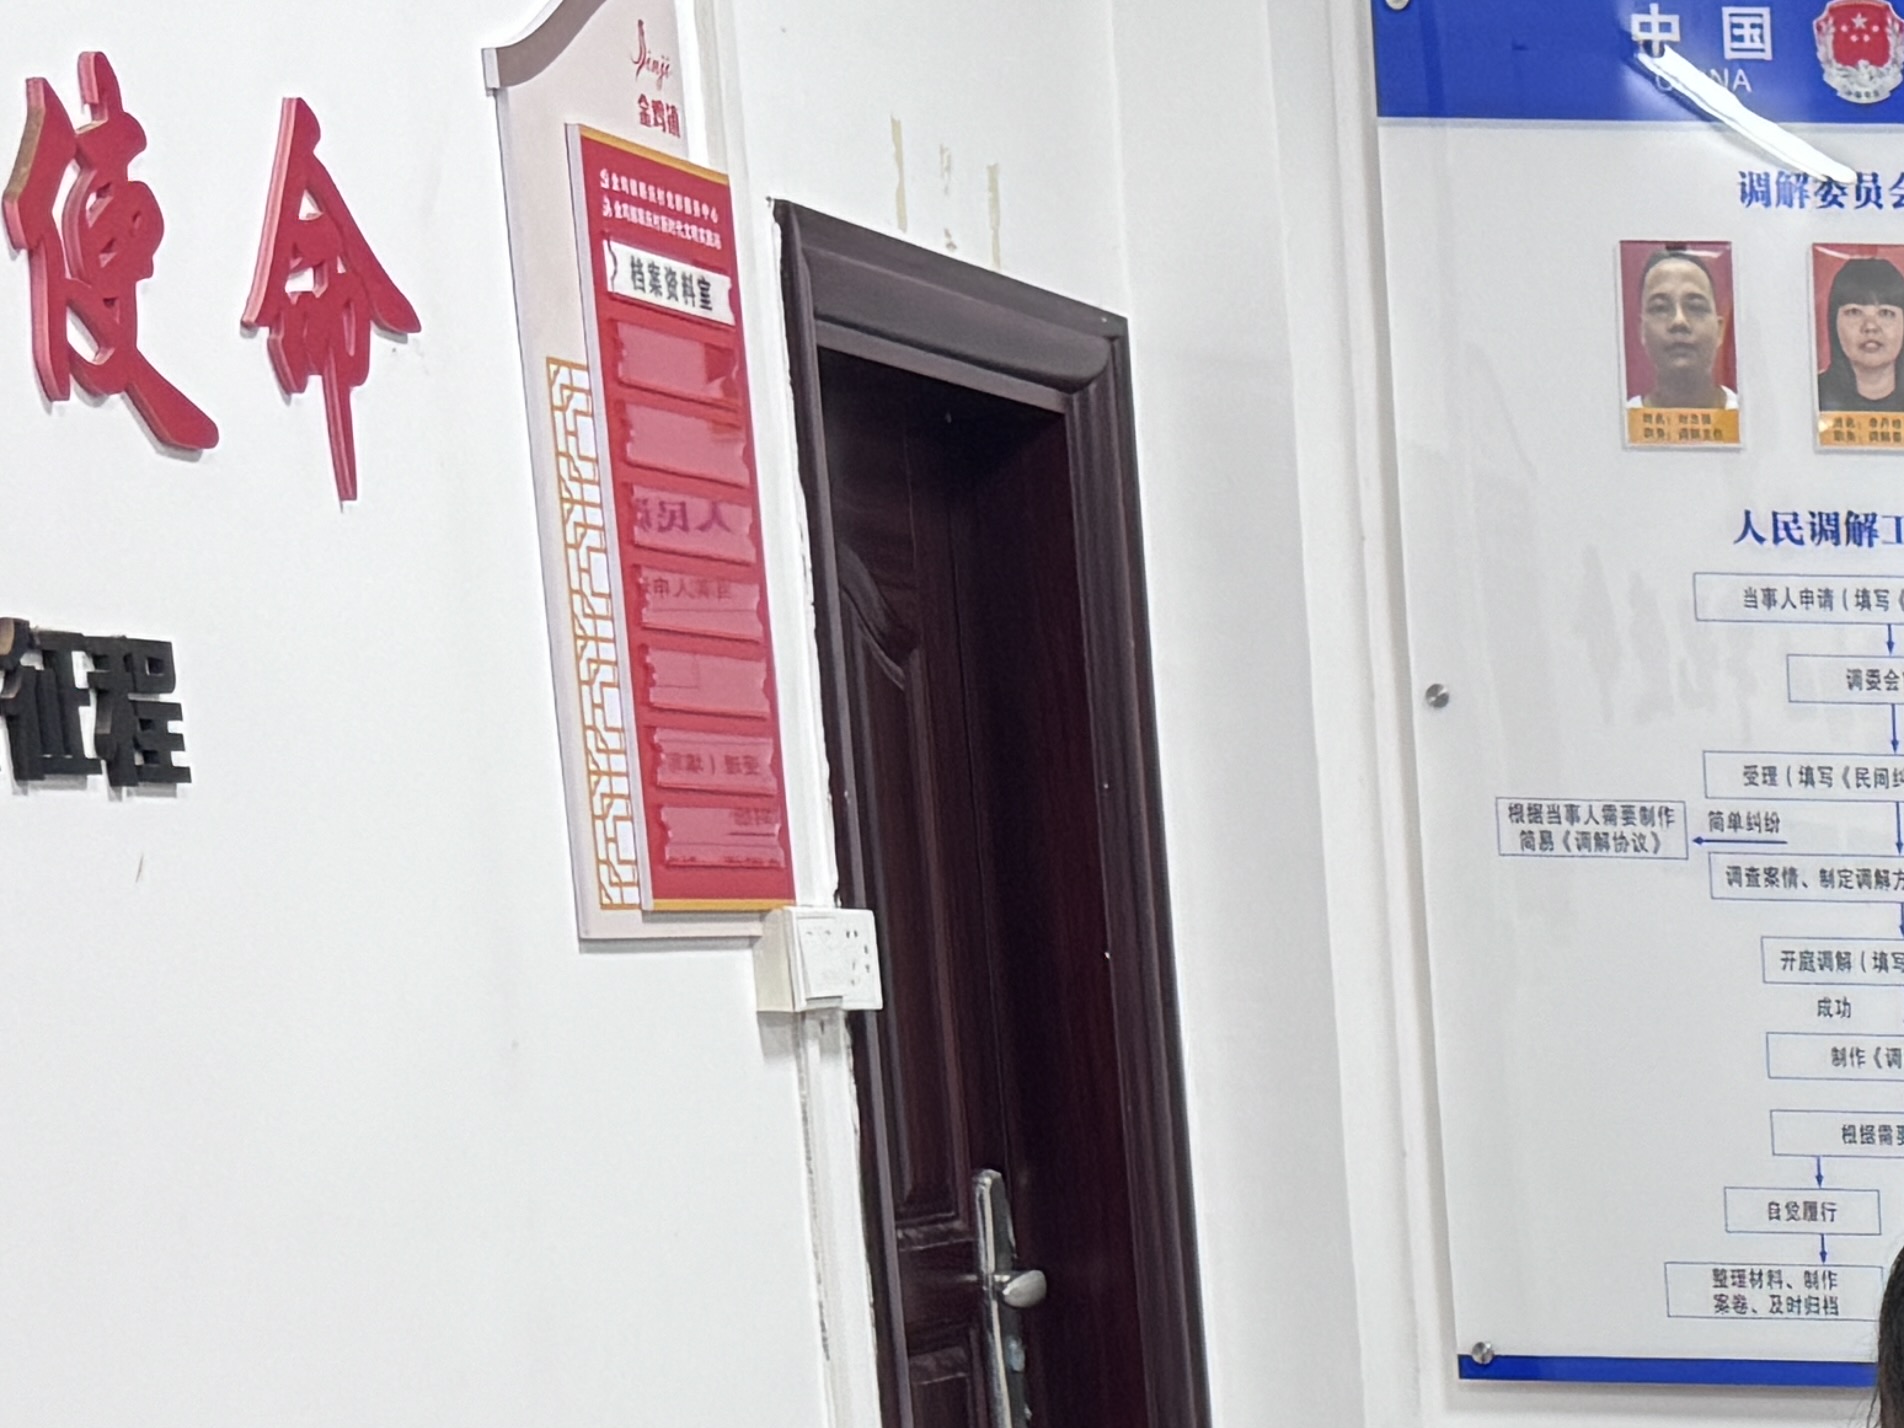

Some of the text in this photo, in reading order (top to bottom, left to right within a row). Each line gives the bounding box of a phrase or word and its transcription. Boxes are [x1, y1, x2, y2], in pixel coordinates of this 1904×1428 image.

[1630, 3, 1774, 61] 中国
[630, 255, 712, 311] 档案资料室
[1507, 803, 1676, 829] 根据当事人需要制作
[1707, 810, 1781, 835] 简单纠纷
[1816, 997, 1852, 1020] 成功
[1767, 1201, 1837, 1223] 自觉履行
[1711, 1268, 1838, 1290] 整理材料、制作
[1713, 1293, 1839, 1316] 案卷、及时归档
